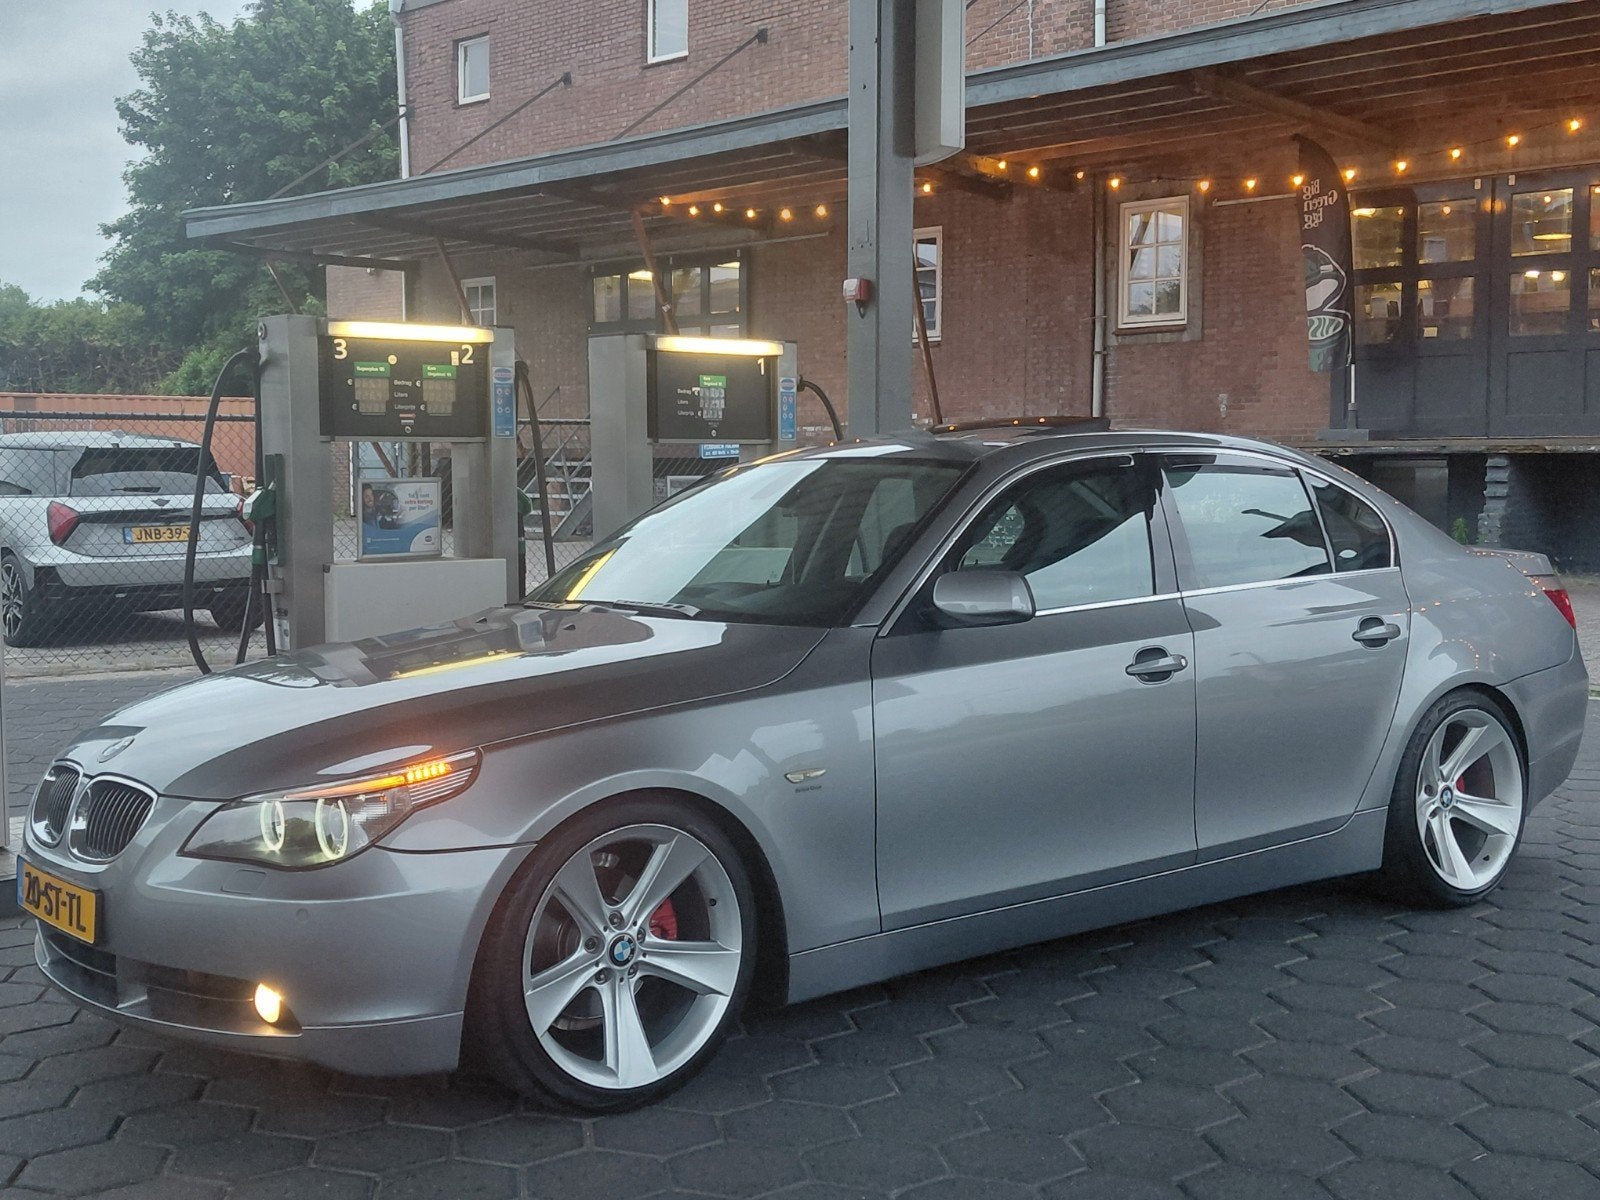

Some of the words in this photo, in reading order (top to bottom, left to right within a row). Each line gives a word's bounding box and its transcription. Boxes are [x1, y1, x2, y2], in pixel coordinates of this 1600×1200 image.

[333, 338, 348, 360] 3
[461, 344, 474, 364] 2
[757, 357, 765, 376] 1
[393, 379, 412, 387] Bedrag
[136, 527, 191, 541] JNB-39-
[25, 871, 87, 933] 20-ST-TL
